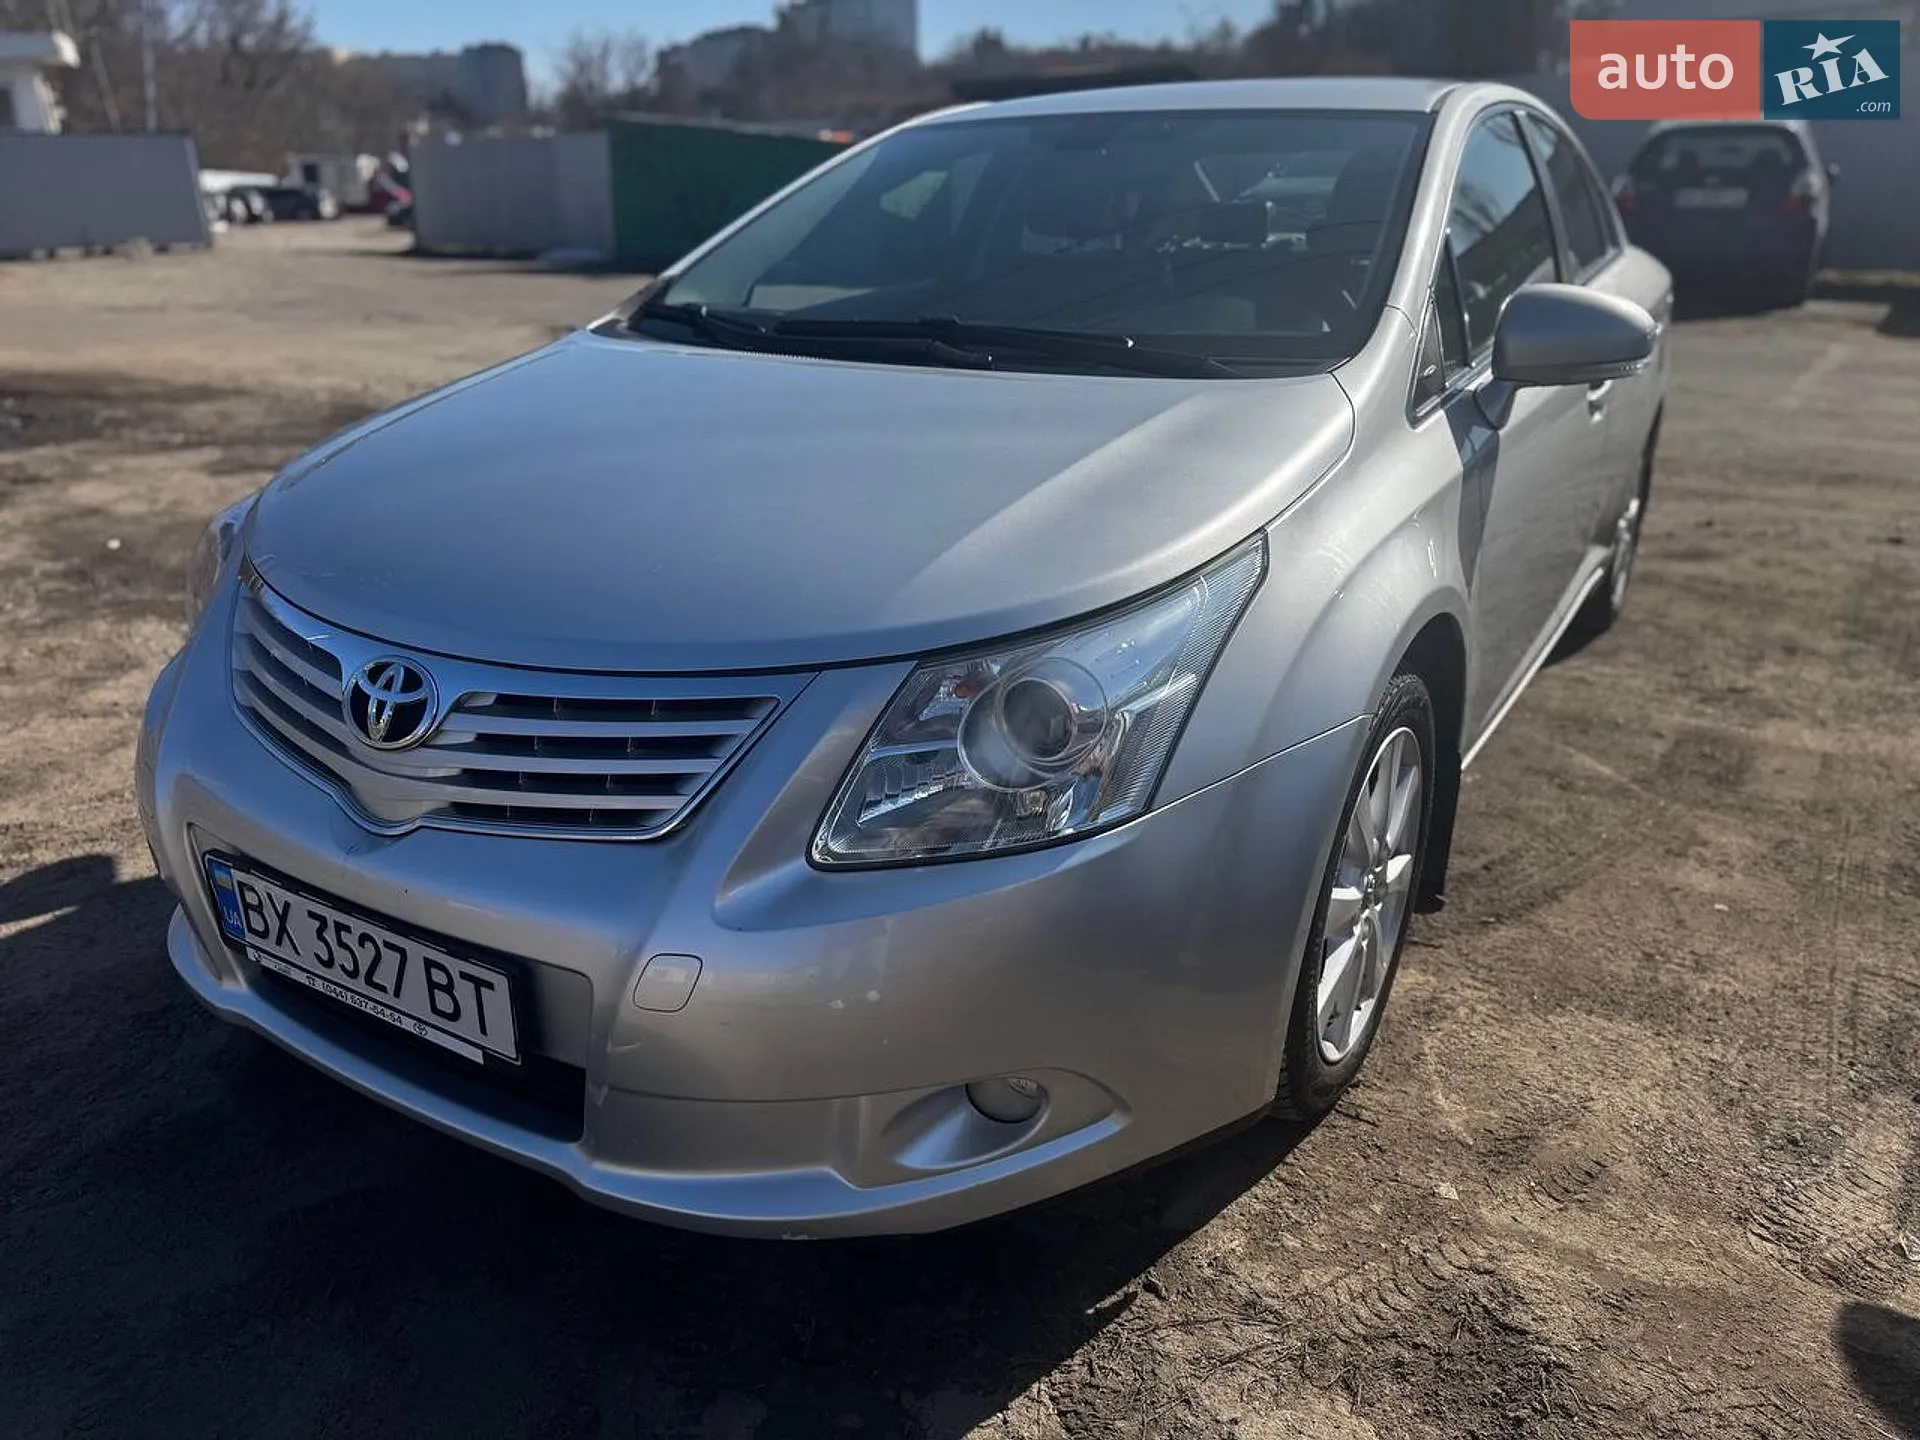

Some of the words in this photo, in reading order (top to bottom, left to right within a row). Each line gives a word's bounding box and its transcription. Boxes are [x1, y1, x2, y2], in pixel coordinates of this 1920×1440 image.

[223, 906, 242, 929] UA
[236, 880, 301, 956] BX
[307, 910, 408, 998] 3527
[423, 956, 495, 1036] BT
